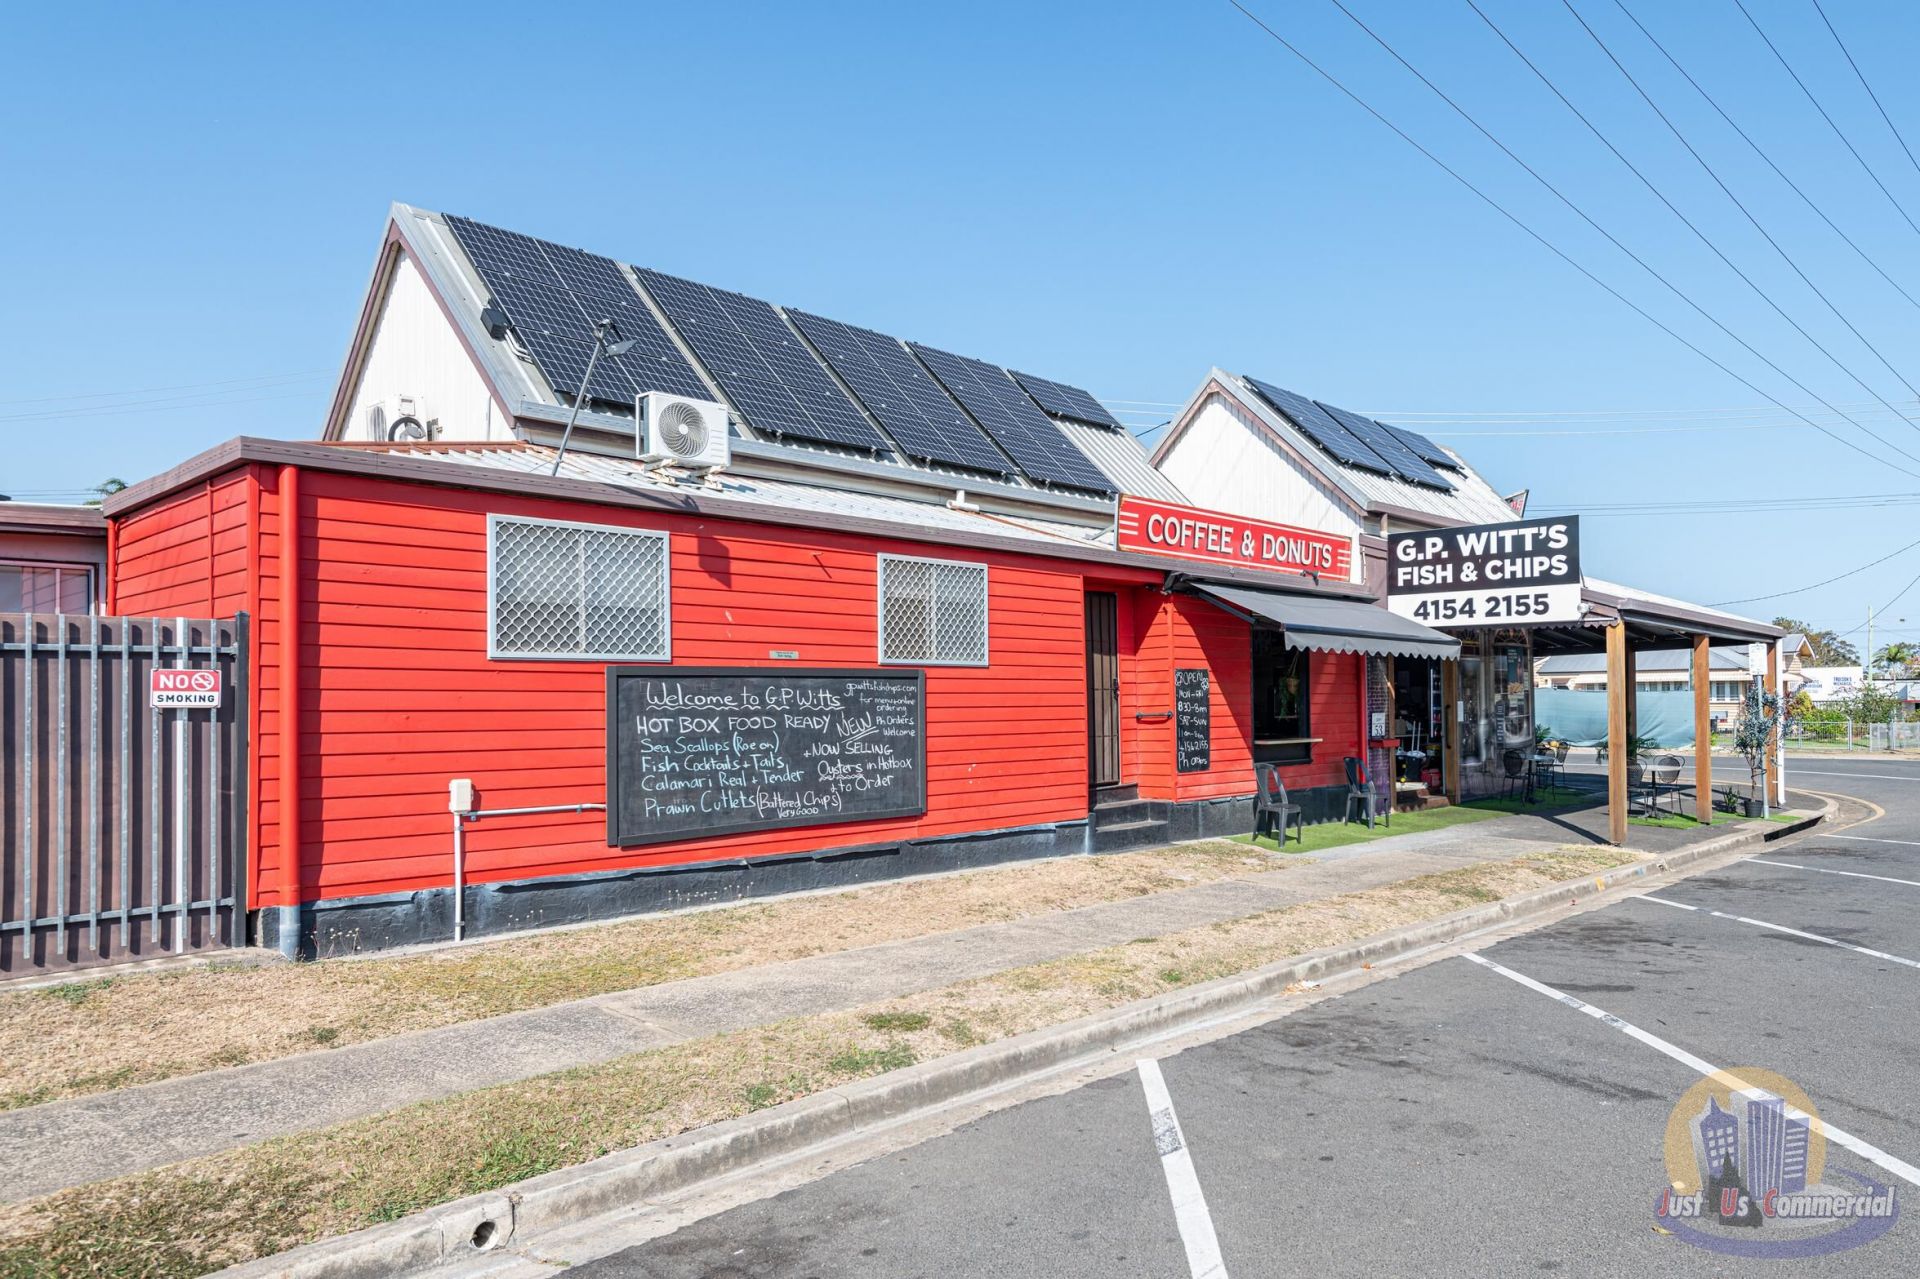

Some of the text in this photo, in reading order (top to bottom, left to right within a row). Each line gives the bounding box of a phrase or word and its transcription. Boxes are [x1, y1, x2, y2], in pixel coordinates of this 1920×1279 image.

[1147, 513, 1333, 568] COFFEE & DONUTS
[1396, 524, 1568, 561] G.P. WITT'S
[1397, 554, 1568, 587] FISH & CHIPS
[1413, 593, 1550, 620] 4154 2155
[159, 674, 189, 689] NO
[1182, 671, 1204, 685] OPEN
[157, 694, 215, 703] SMOKING
[646, 682, 738, 707] Welcome
[740, 685, 760, 705] to
[636, 713, 831, 736] HOT BOX FOOD READY
[836, 711, 872, 738] NEW
[886, 714, 915, 726] Orders
[882, 726, 916, 737] Welcome
[640, 737, 671, 754] Sea
[674, 736, 730, 756] Scallops
[845, 741, 894, 756] SELLING
[641, 755, 680, 772] Fish
[684, 754, 741, 771] Cocktails
[749, 751, 785, 771] Tails
[817, 758, 864, 777] Oysters
[866, 759, 877, 770] in
[641, 773, 713, 792] Calamari
[718, 769, 747, 787] Real
[759, 761, 805, 785] Tender
[855, 774, 895, 791] Order
[644, 797, 696, 818] Prawn
[700, 789, 757, 813] Cutlets
